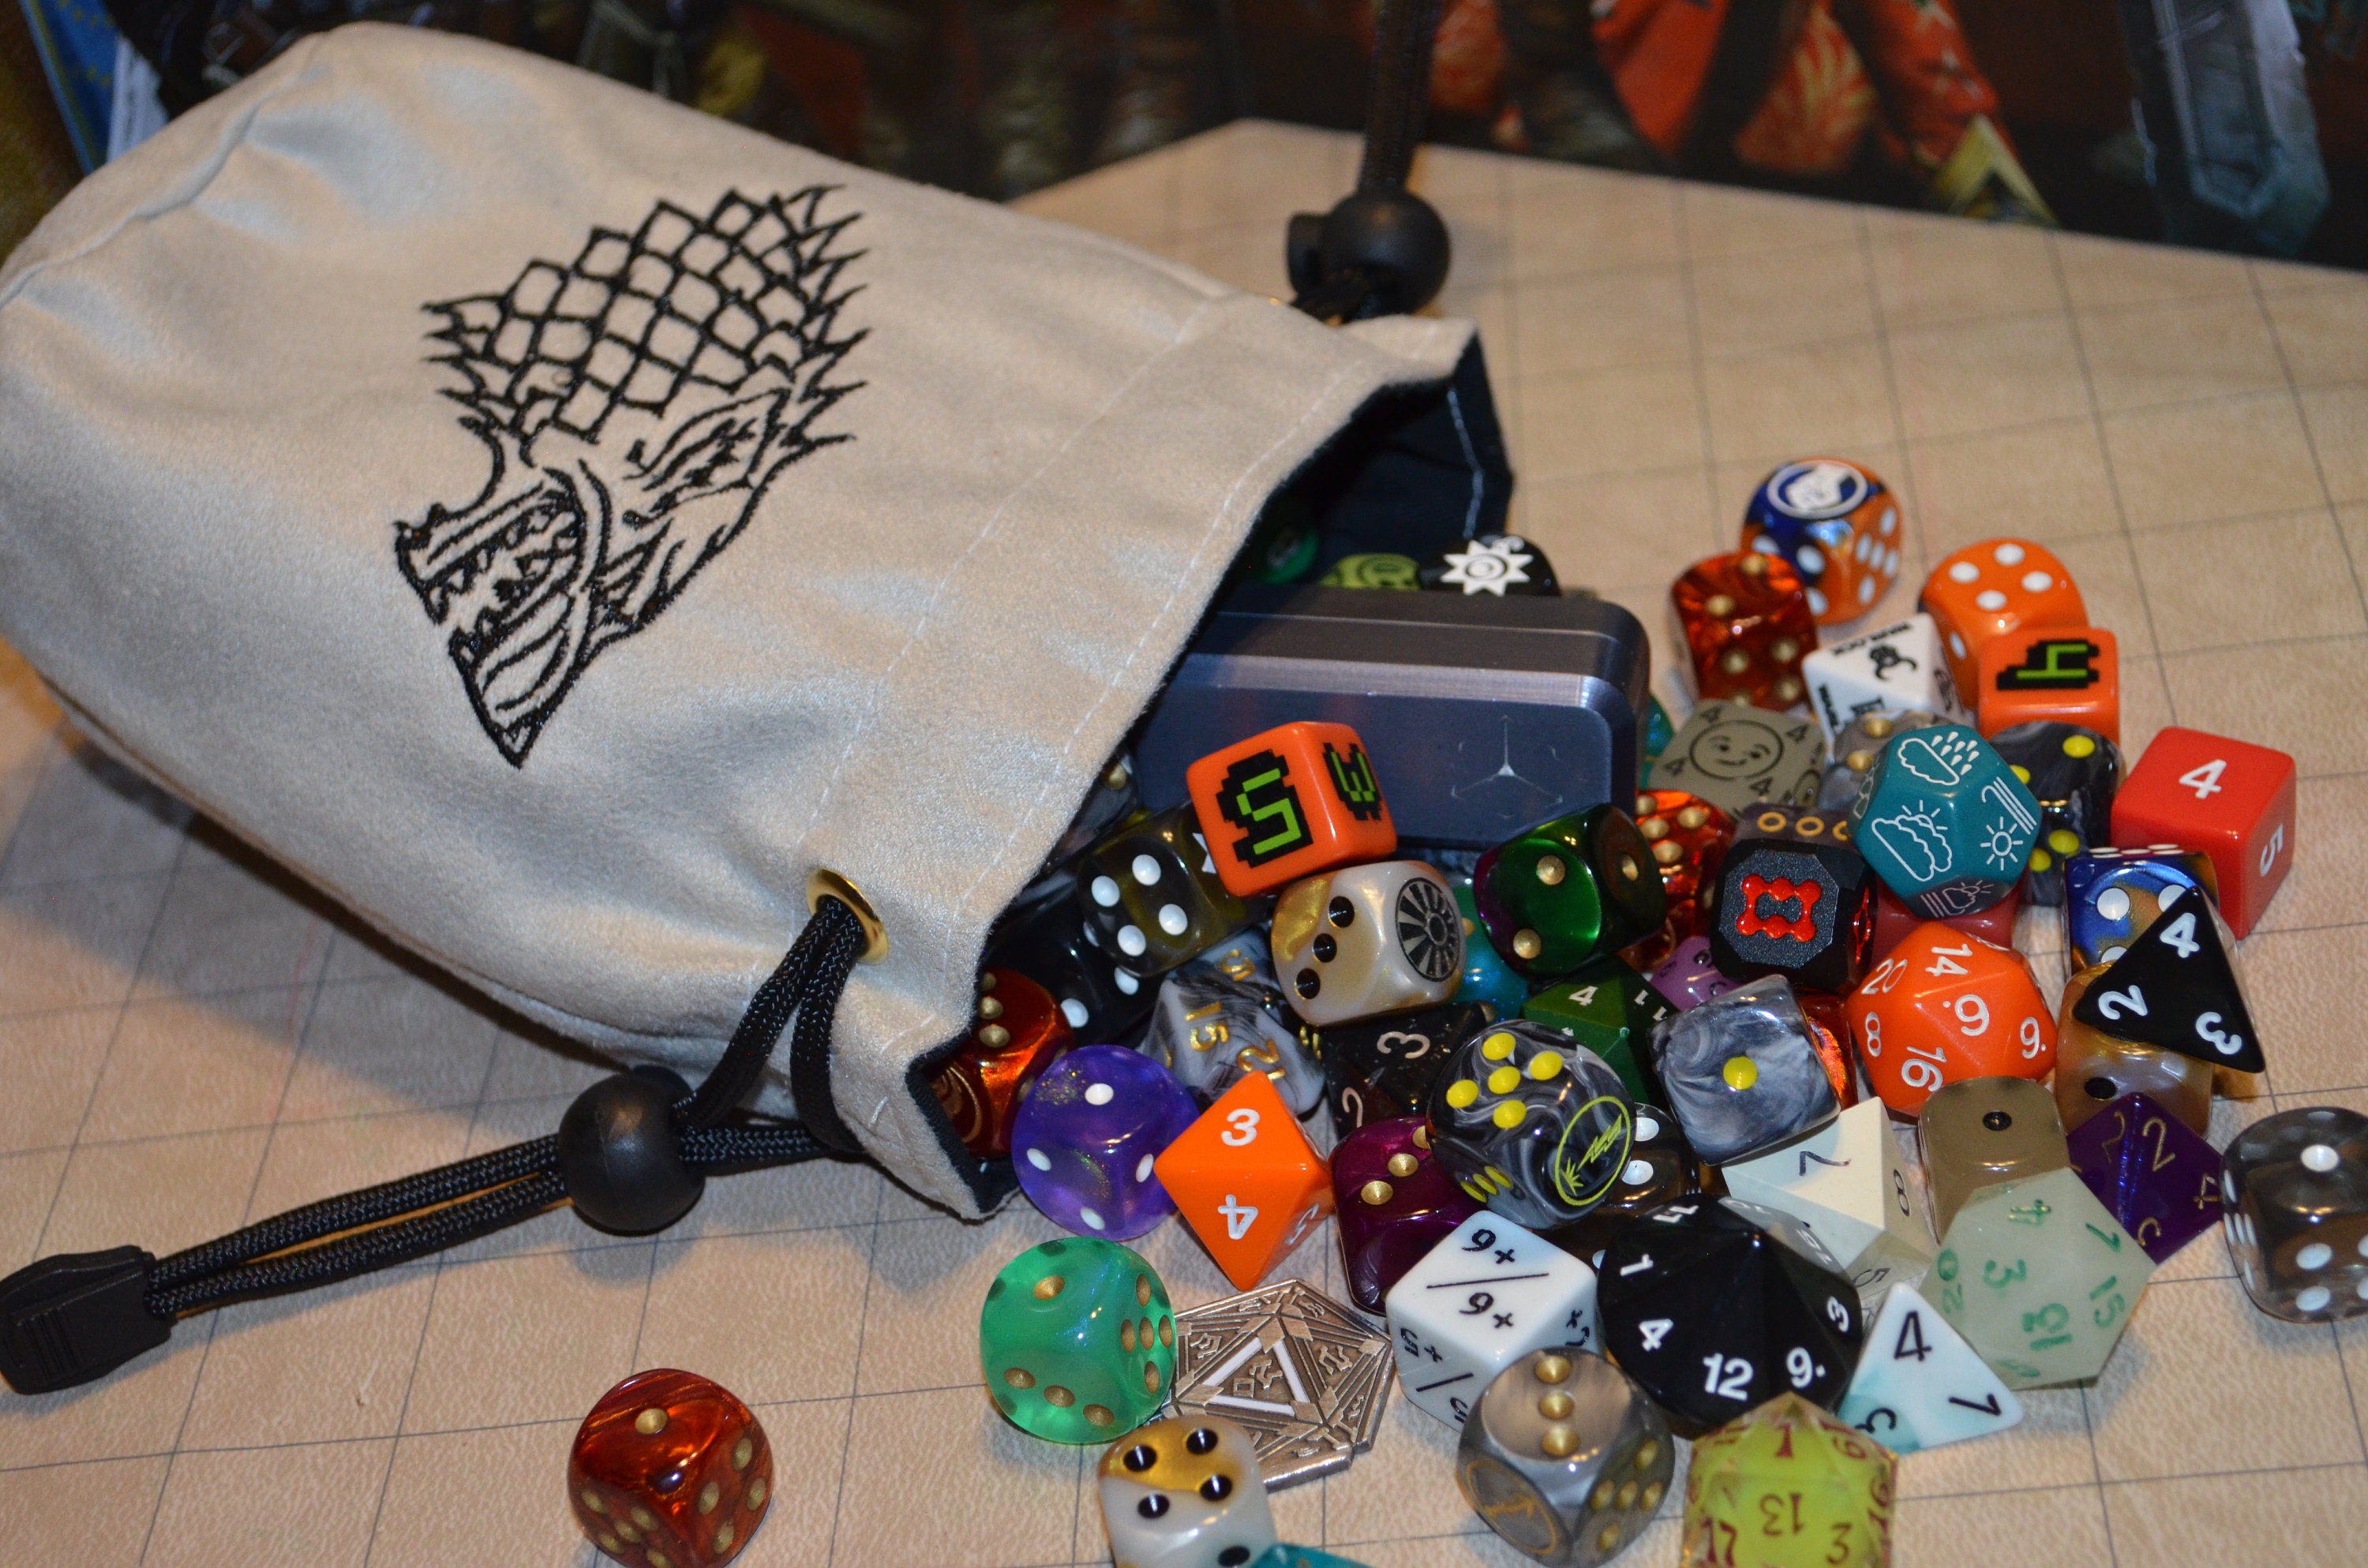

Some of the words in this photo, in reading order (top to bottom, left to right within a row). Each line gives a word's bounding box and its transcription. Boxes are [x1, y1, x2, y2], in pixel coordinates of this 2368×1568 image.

[1785, 724, 1809, 743] 4
[1664, 757, 1687, 776] 4
[2179, 758, 2227, 799] 4
[2260, 823, 2284, 877] 5
[2160, 912, 2201, 959] 4
[1860, 958, 1908, 995] 20
[1925, 943, 1973, 977] 14
[1568, 986, 1599, 1006] 4
[2098, 985, 2149, 1020] 2
[1185, 1001, 1230, 1050] 15
[1377, 1031, 1430, 1059] 3
[1864, 1012, 1882, 1057] 8
[2195, 1012, 2242, 1055] 3
[1902, 1046, 1947, 1092] 16
[1221, 1108, 1260, 1146] 3
[2142, 1117, 2176, 1172] 2
[1653, 1204, 1699, 1223] 11
[1894, 1168, 1910, 1217] 8
[1218, 1194, 1258, 1240] 4
[1620, 1253, 1654, 1277] 1
[1983, 1259, 2027, 1289] 3
[2089, 1275, 2125, 1329] 15
[1639, 1318, 1673, 1352] 4
[1894, 1311, 1932, 1362] 4
[1703, 1353, 1754, 1401] 12
[1775, 1423, 1794, 1458] 1
[1759, 1492, 1804, 1536] 13
[1701, 1516, 1737, 1566] 17
[1827, 1522, 1853, 1565] 3
